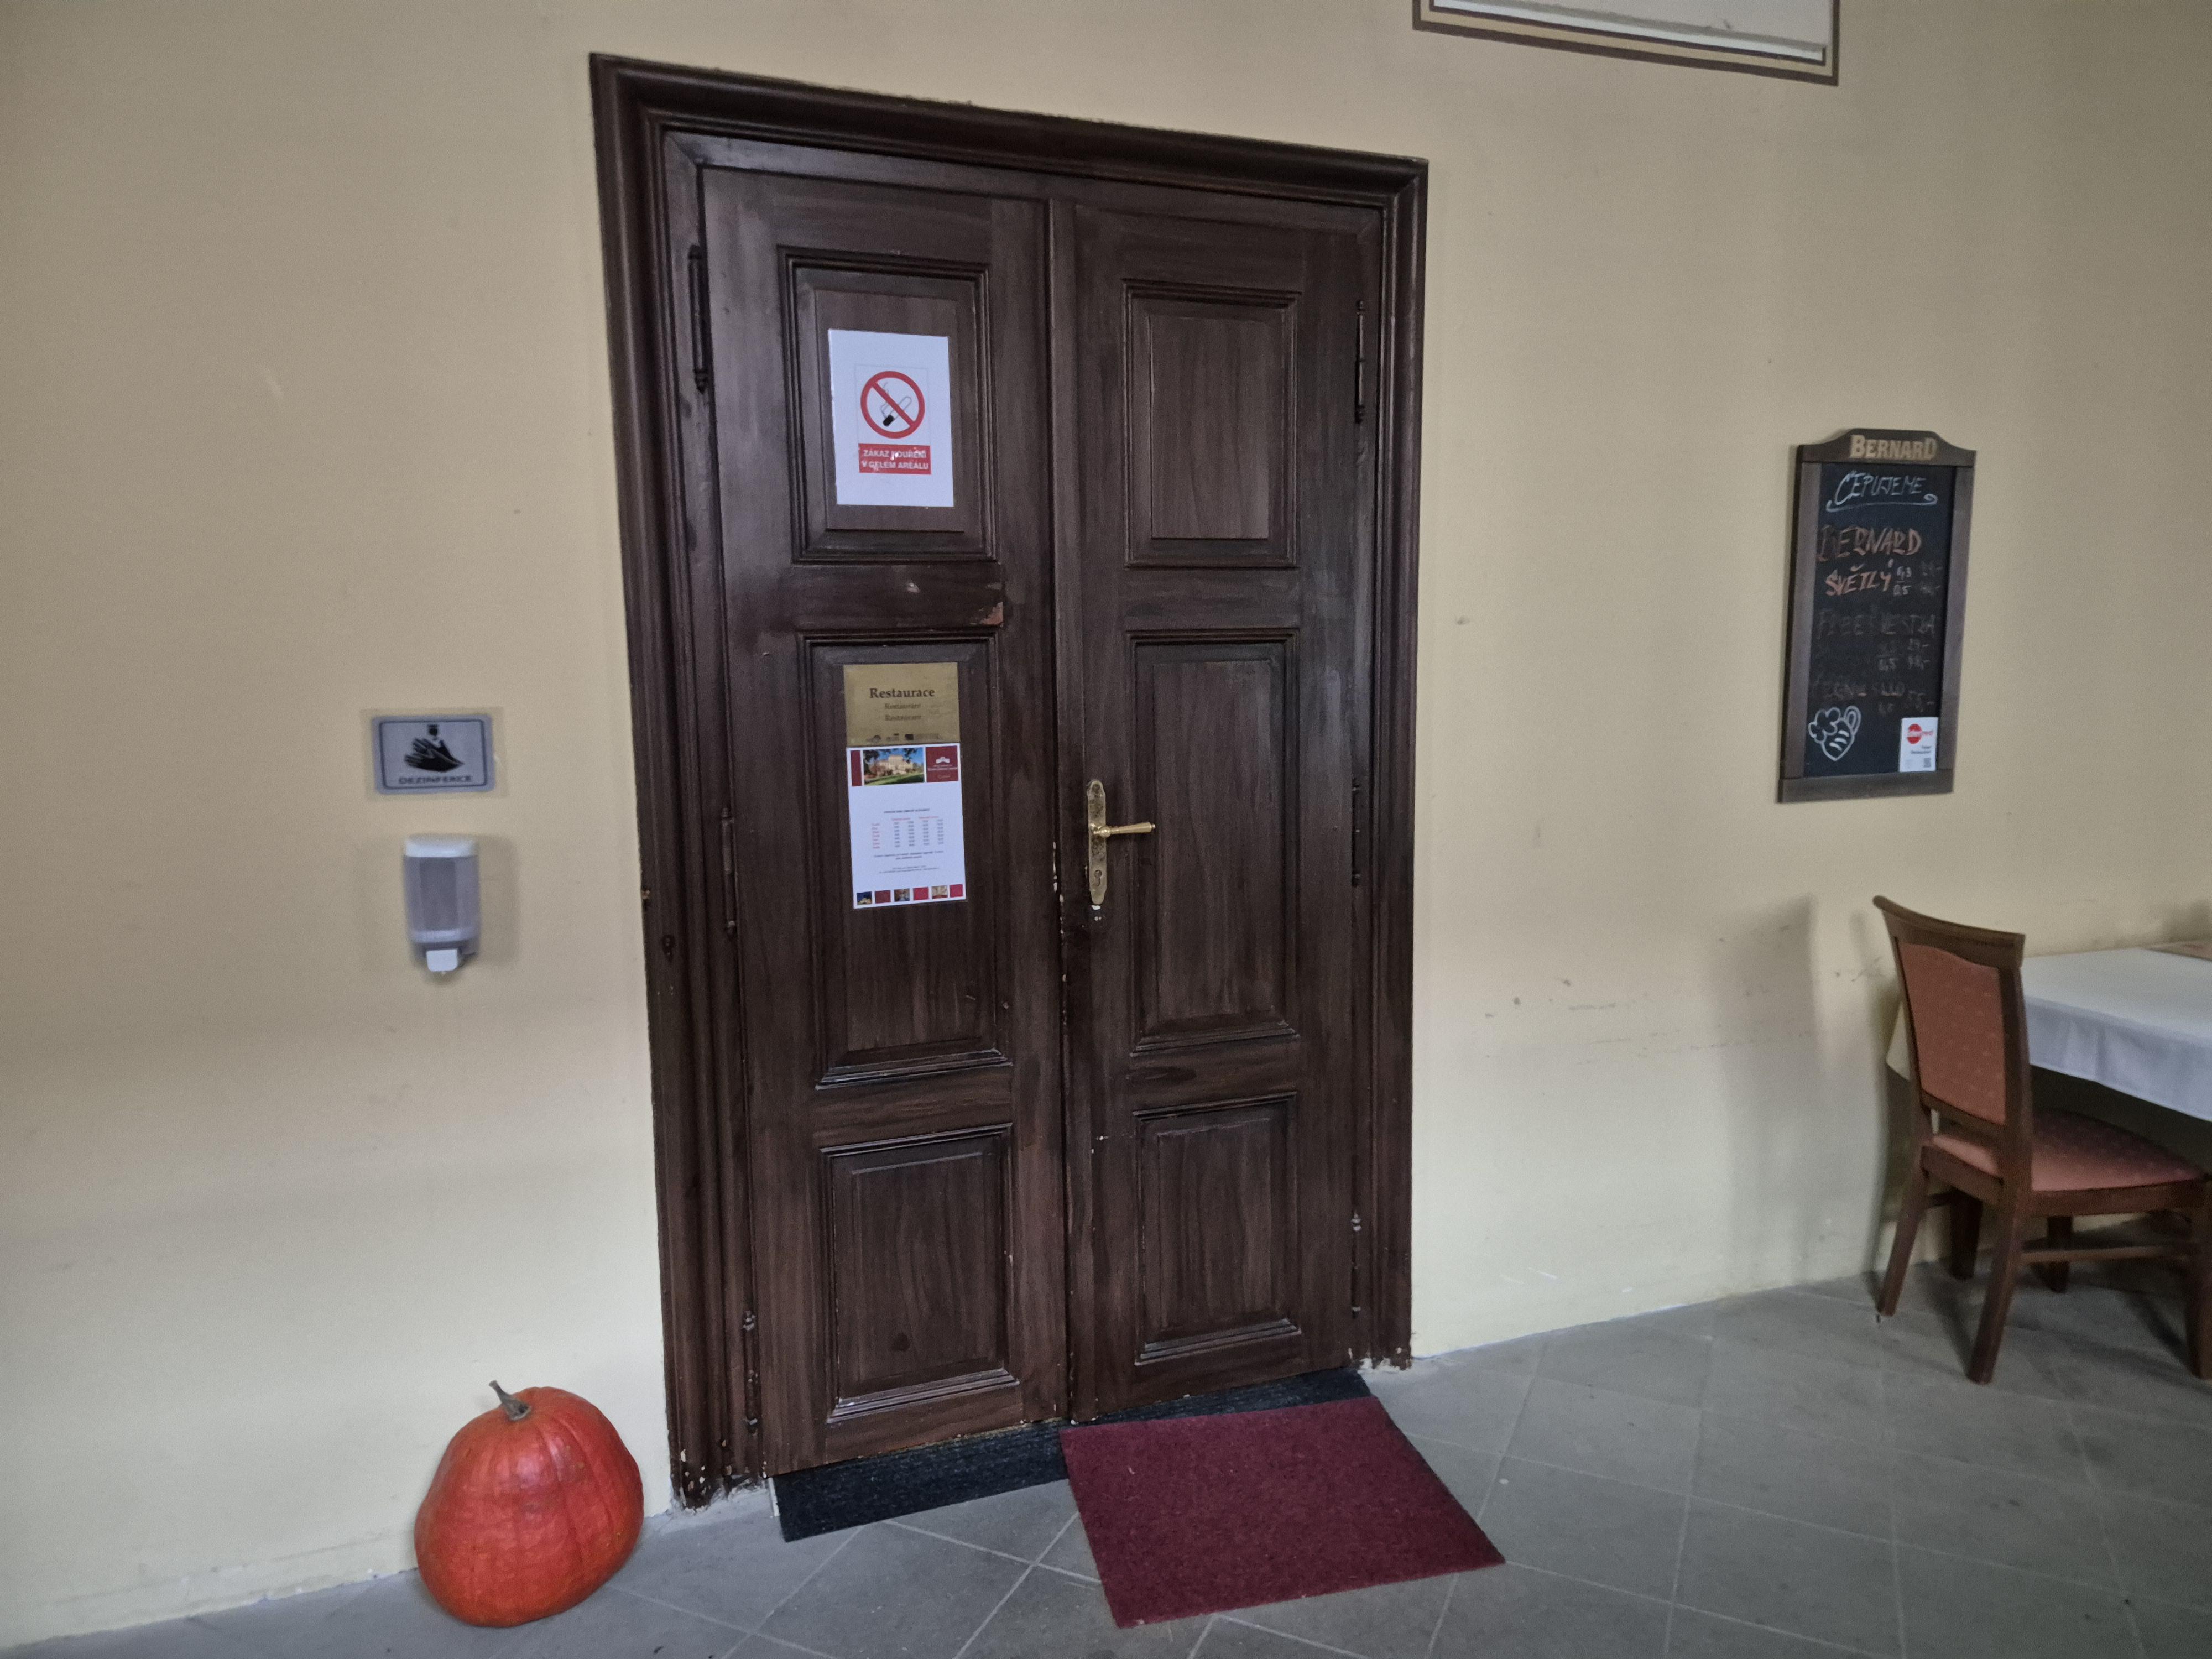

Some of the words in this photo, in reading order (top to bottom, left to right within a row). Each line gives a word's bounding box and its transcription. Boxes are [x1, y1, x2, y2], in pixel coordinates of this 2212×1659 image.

[863, 448, 889, 458] ZÁKAZ
[1850, 434, 1937, 461] BERNARD
[869, 688, 935, 699] Restaurace
